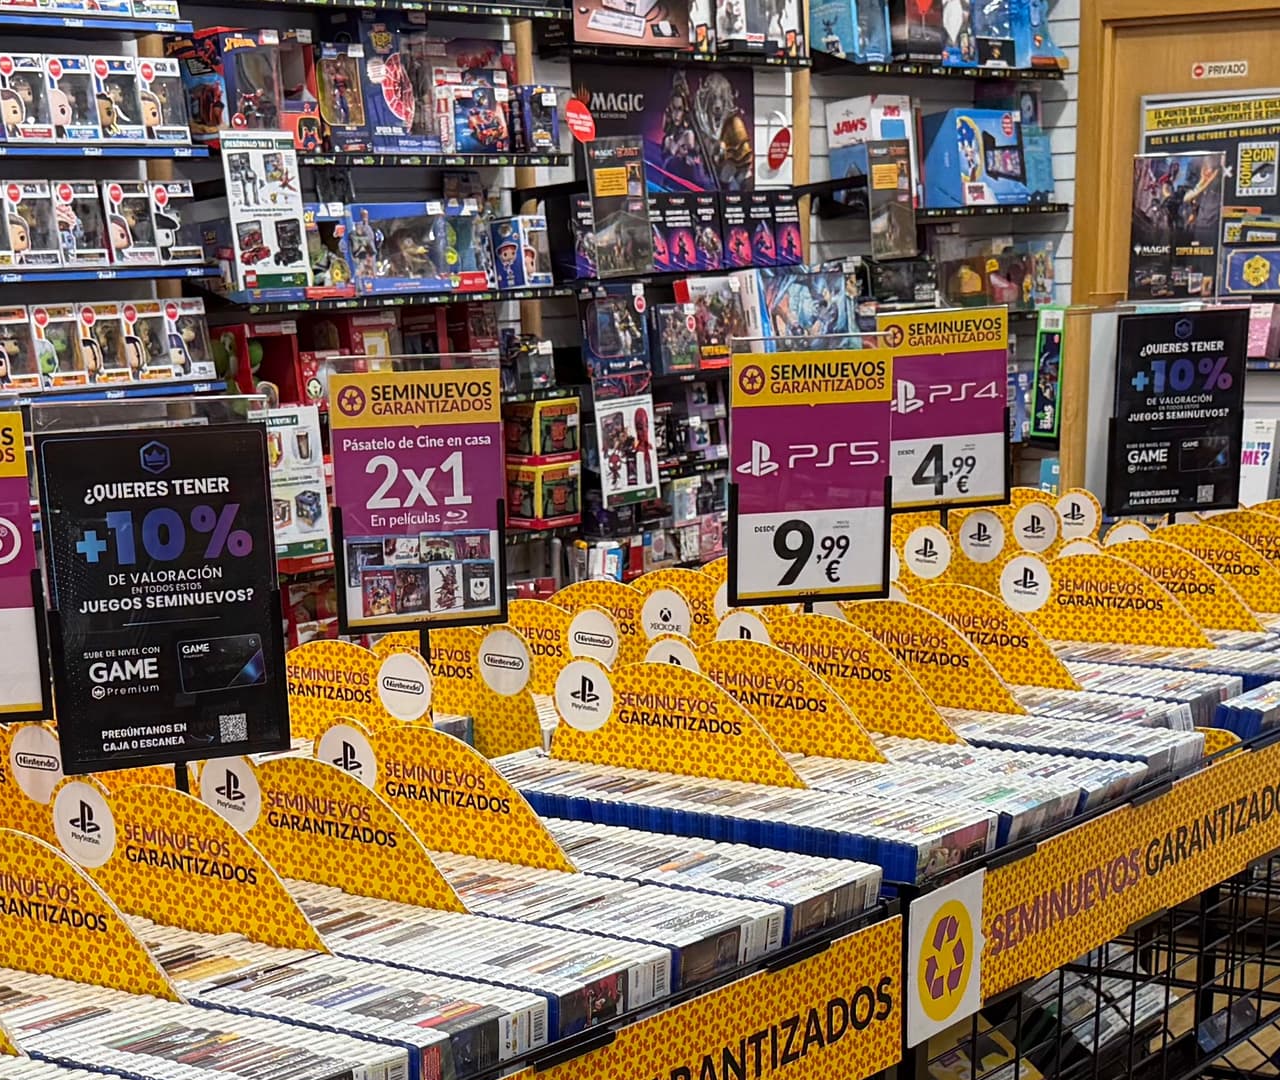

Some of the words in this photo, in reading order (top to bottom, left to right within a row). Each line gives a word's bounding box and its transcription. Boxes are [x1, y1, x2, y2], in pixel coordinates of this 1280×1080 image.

[1208, 64, 1246, 75] PRIVADO
[590, 93, 644, 112] MAGIC
[833, 118, 867, 136] JAWS
[1253, 149, 1275, 161] CON
[1140, 343, 1188, 357] ¿QUIERES
[1191, 341, 1224, 352] TENER
[771, 361, 885, 380] SEMINUEVOS
[1132, 357, 1233, 393] +10%
[371, 381, 492, 400] SEMINUEVOS
[771, 376, 886, 395] GARANTIZADOS
[929, 381, 998, 401] PS4
[371, 398, 492, 415] GARANTIZADOS
[1128, 410, 1164, 422] JUEGOS
[1166, 408, 1229, 419] SEMINUEVOS?
[343, 435, 396, 452] Pásatelo
[399, 436, 413, 449] de
[417, 434, 443, 448] Cine
[447, 437, 461, 447] en
[464, 435, 491, 446] casa
[789, 442, 880, 468] PS5
[366, 452, 472, 509] 2x1
[84, 481, 168, 504] ¿QUIERES
[172, 477, 229, 496] TENER
[370, 514, 386, 527] En
[390, 511, 440, 527] películas
[76, 504, 253, 565] +10%
[108, 574, 126, 586] DE
[130, 566, 222, 584] VALORACIÓN
[825, 560, 841, 583] €
[131, 586, 142, 595] EN
[144, 584, 173, 593] TODOS
[176, 582, 201, 591] ESTOS
[79, 598, 141, 614] JUEGOS
[146, 588, 254, 608] SEMINUEVOS?
[83, 651, 103, 659] SUBE
[118, 648, 139, 657] NIVEL
[142, 646, 160, 654] CON
[182, 643, 209, 653] GAME
[89, 658, 159, 683] GAME
[107, 683, 159, 696] Premium
[619, 692, 718, 715] SEMINUEVOS
[102, 725, 171, 739] PREGÚNTANOS
[174, 723, 187, 733] EN
[618, 709, 742, 737] GARANTIZADOS
[103, 739, 129, 752] CAJA
[140, 736, 185, 748] ESCANEA
[990, 846, 1142, 958] SEMINUEVOS
